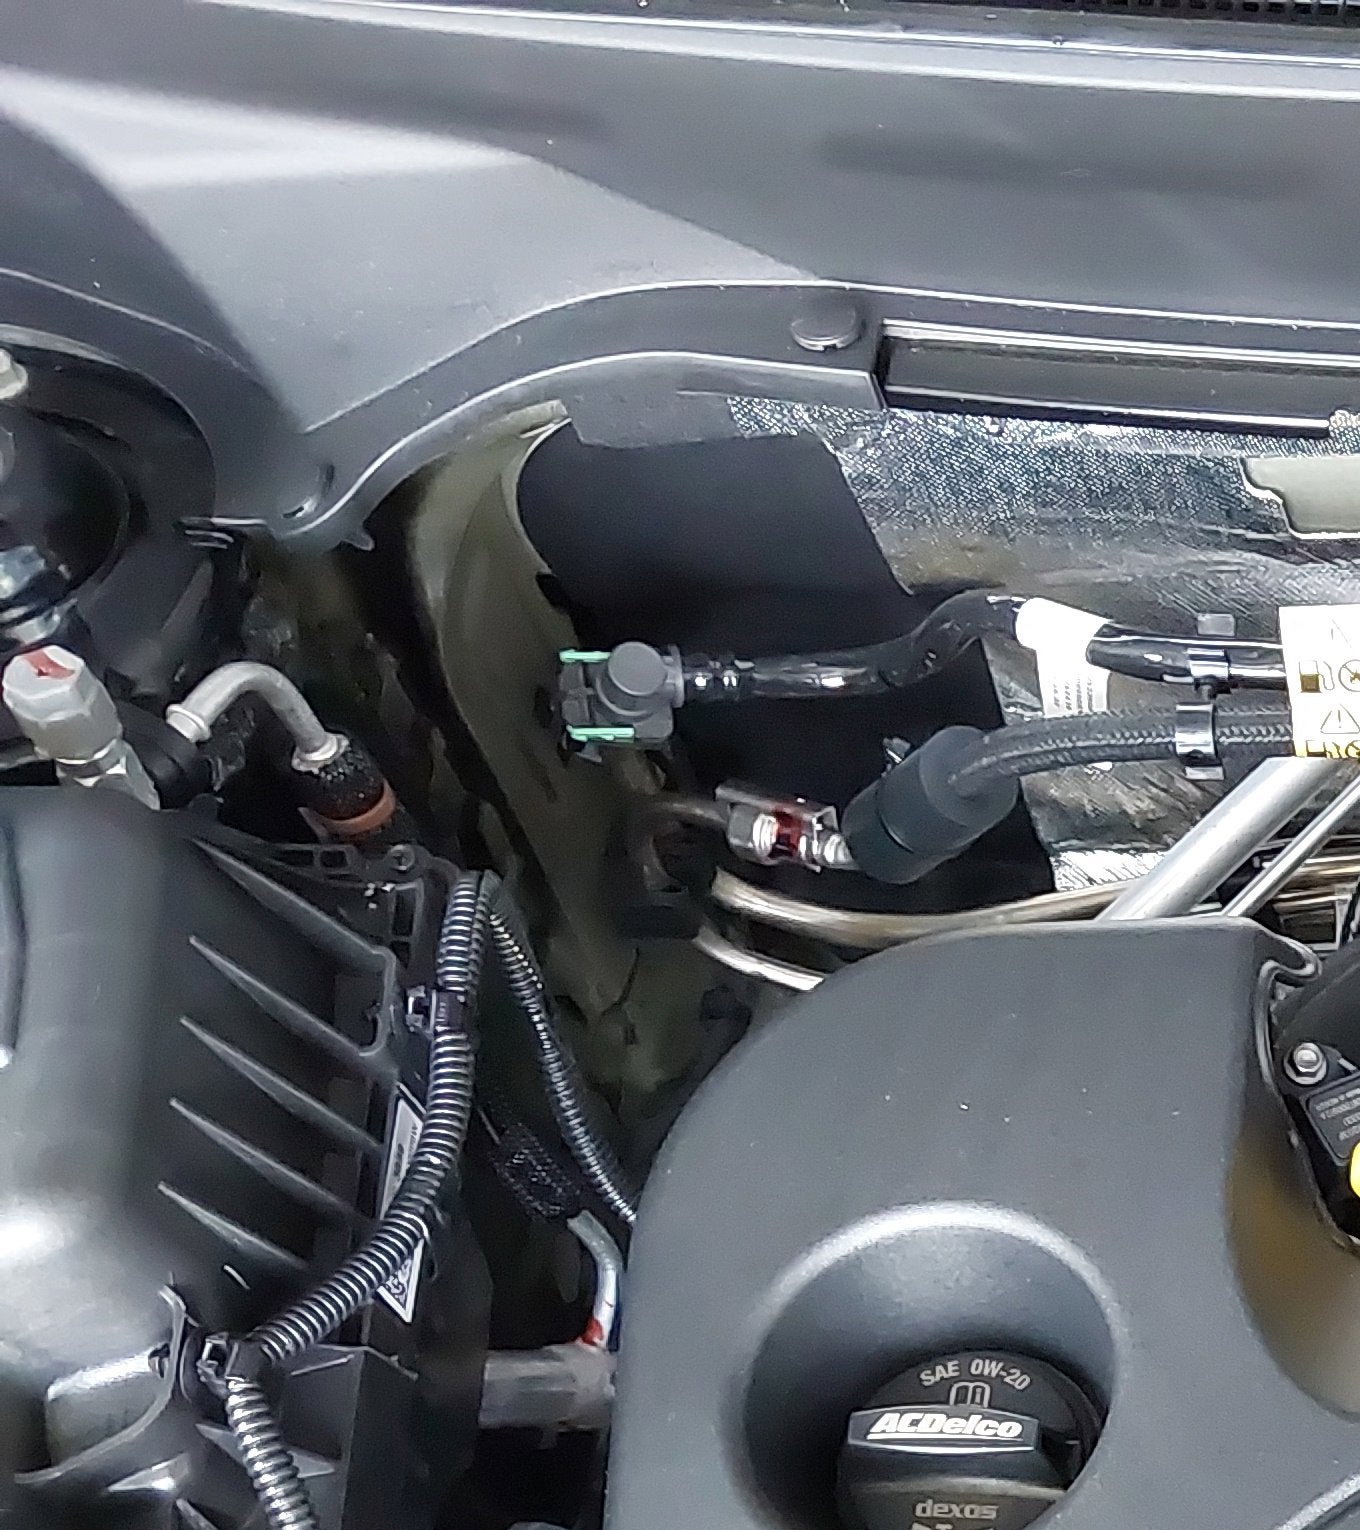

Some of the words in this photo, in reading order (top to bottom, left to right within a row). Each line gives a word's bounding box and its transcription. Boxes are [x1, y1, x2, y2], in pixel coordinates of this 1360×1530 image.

[919, 1359, 960, 1388] SAE
[970, 1358, 1031, 1391] 0W-20
[868, 1412, 1024, 1438] ACDelco
[915, 1498, 999, 1520] dexos
